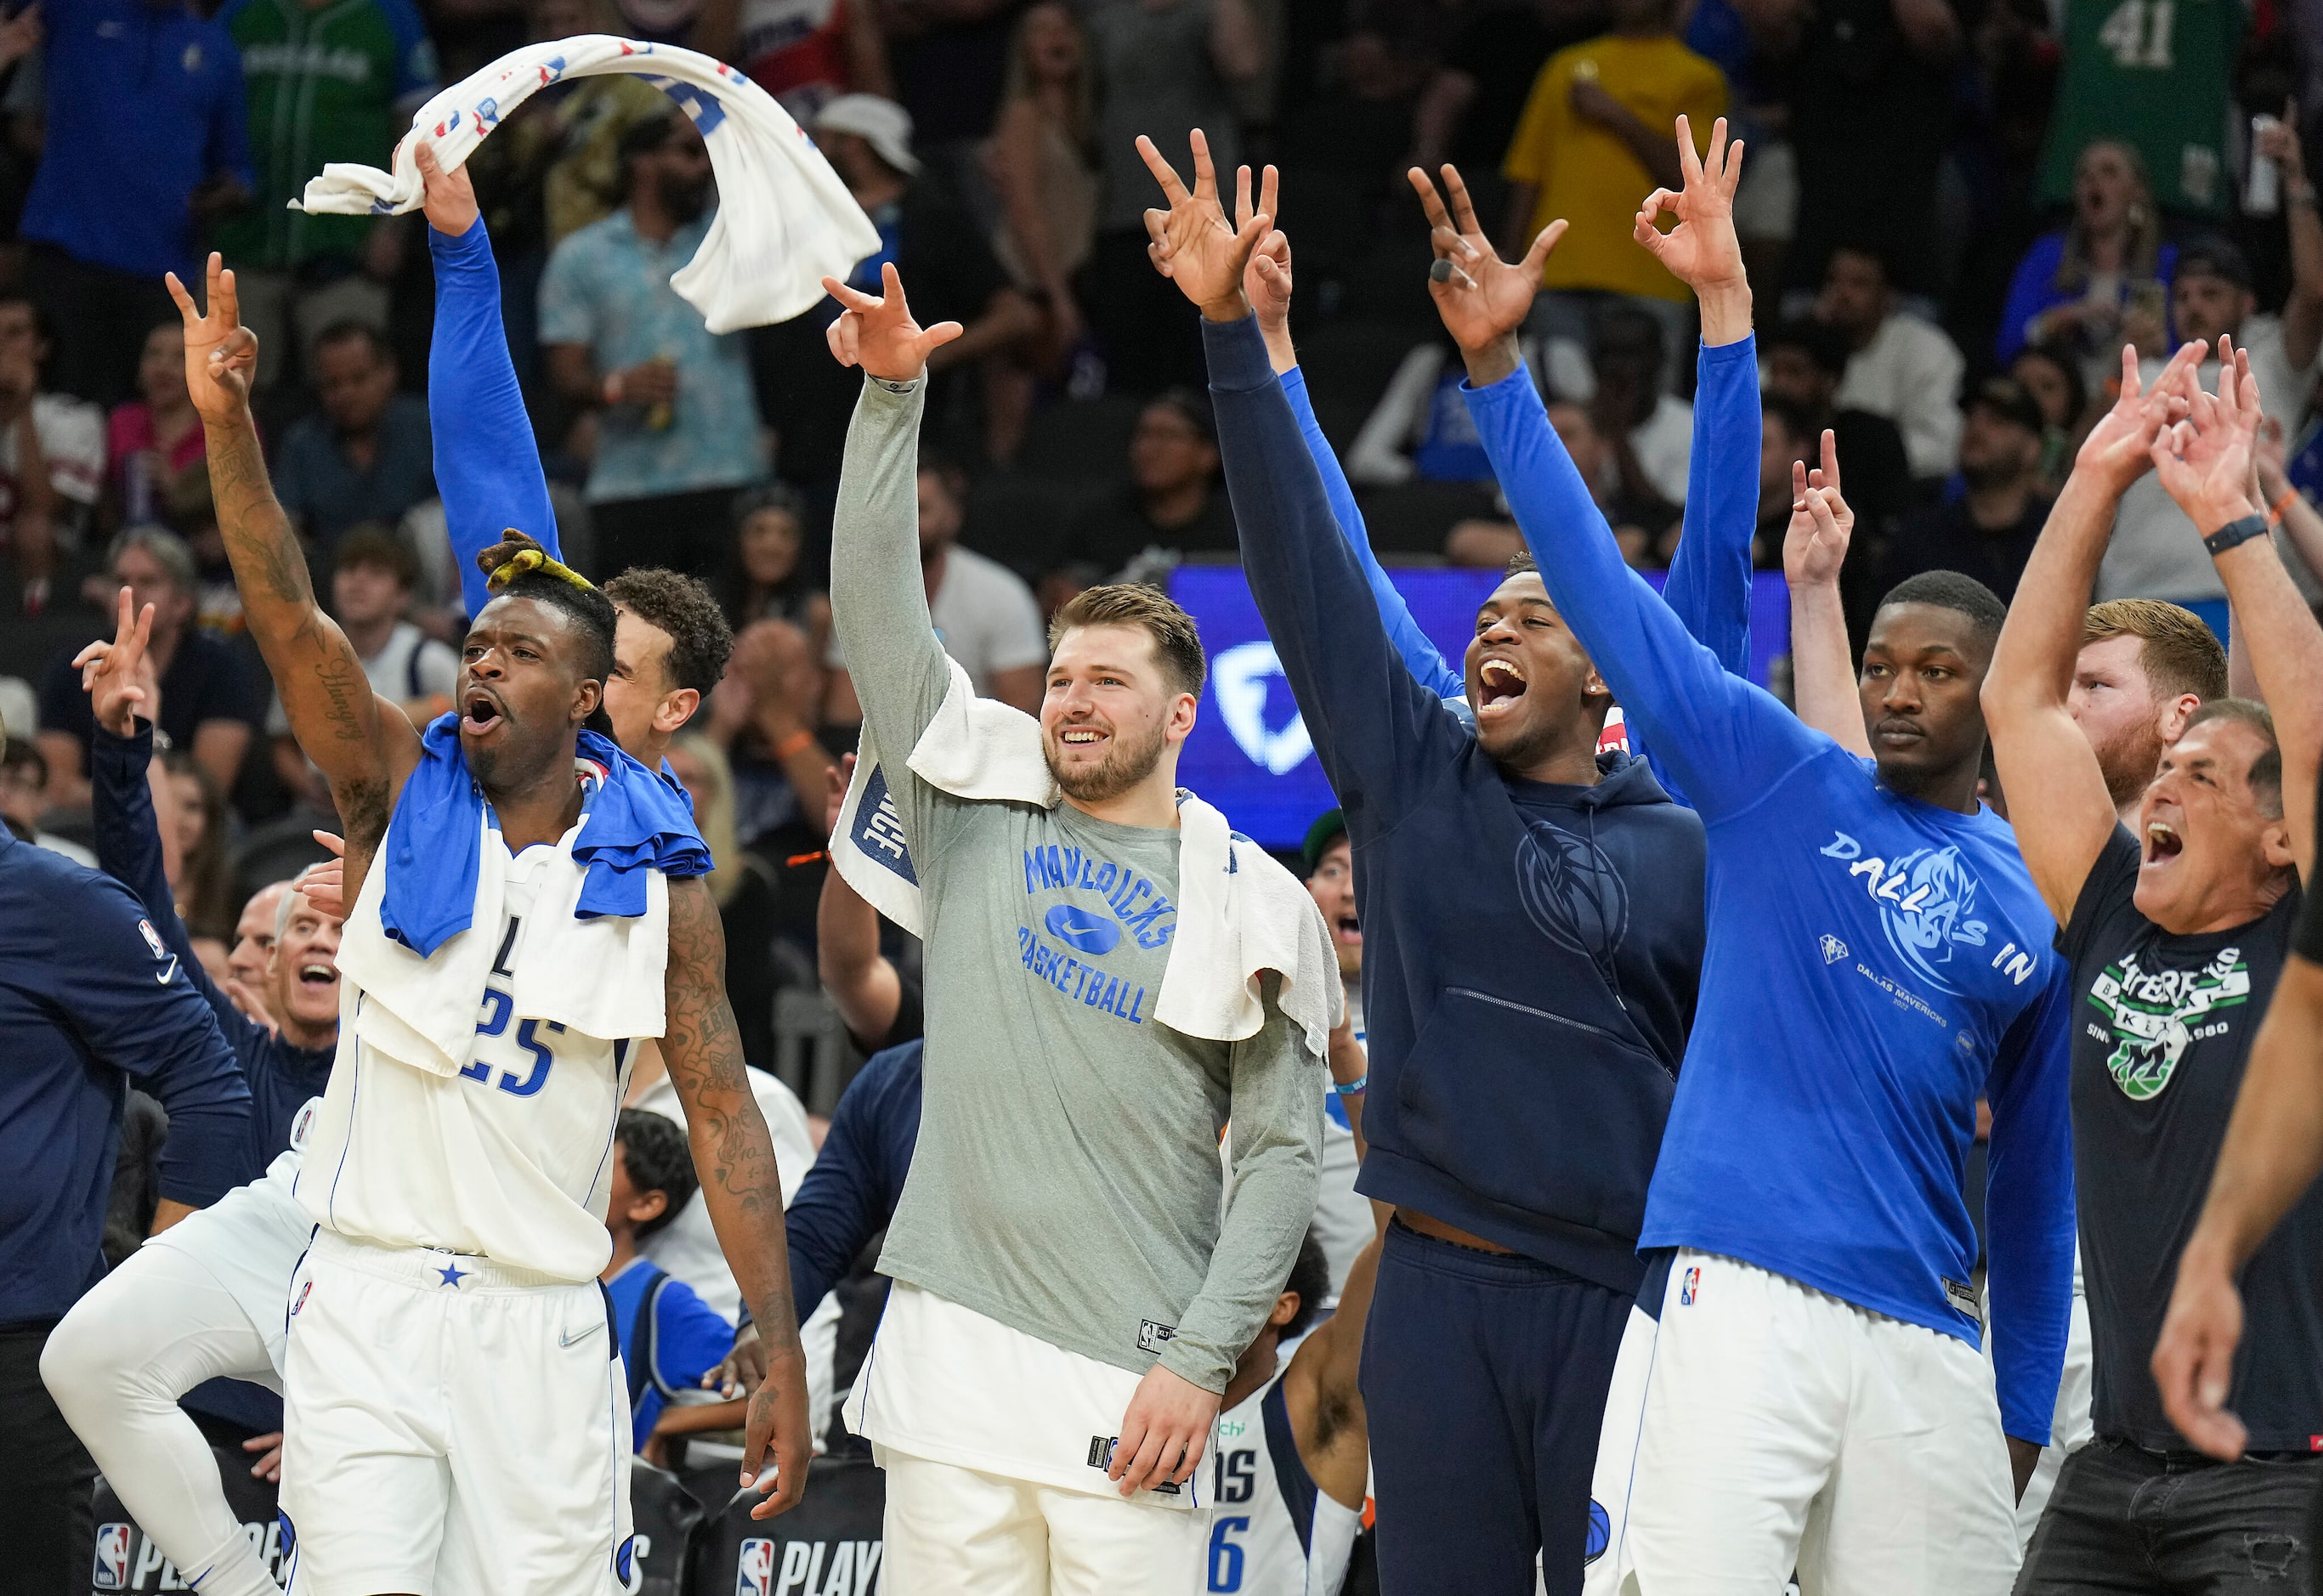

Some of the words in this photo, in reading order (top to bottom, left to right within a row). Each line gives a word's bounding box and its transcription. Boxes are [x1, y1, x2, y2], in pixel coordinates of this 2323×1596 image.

[2099, 0, 2172, 64] 41
[1820, 830, 1989, 948] DALLAS
[1992, 942, 2037, 986] IN
[1856, 963, 1894, 993] DALLAS
[1895, 988, 1947, 1027] MAVERICKS
[1893, 998, 1910, 1011] 2022
[459, 986, 566, 1098] 25
[1157, 1329, 1169, 1338] XLT
[774, 1540, 884, 1596] PLAY
